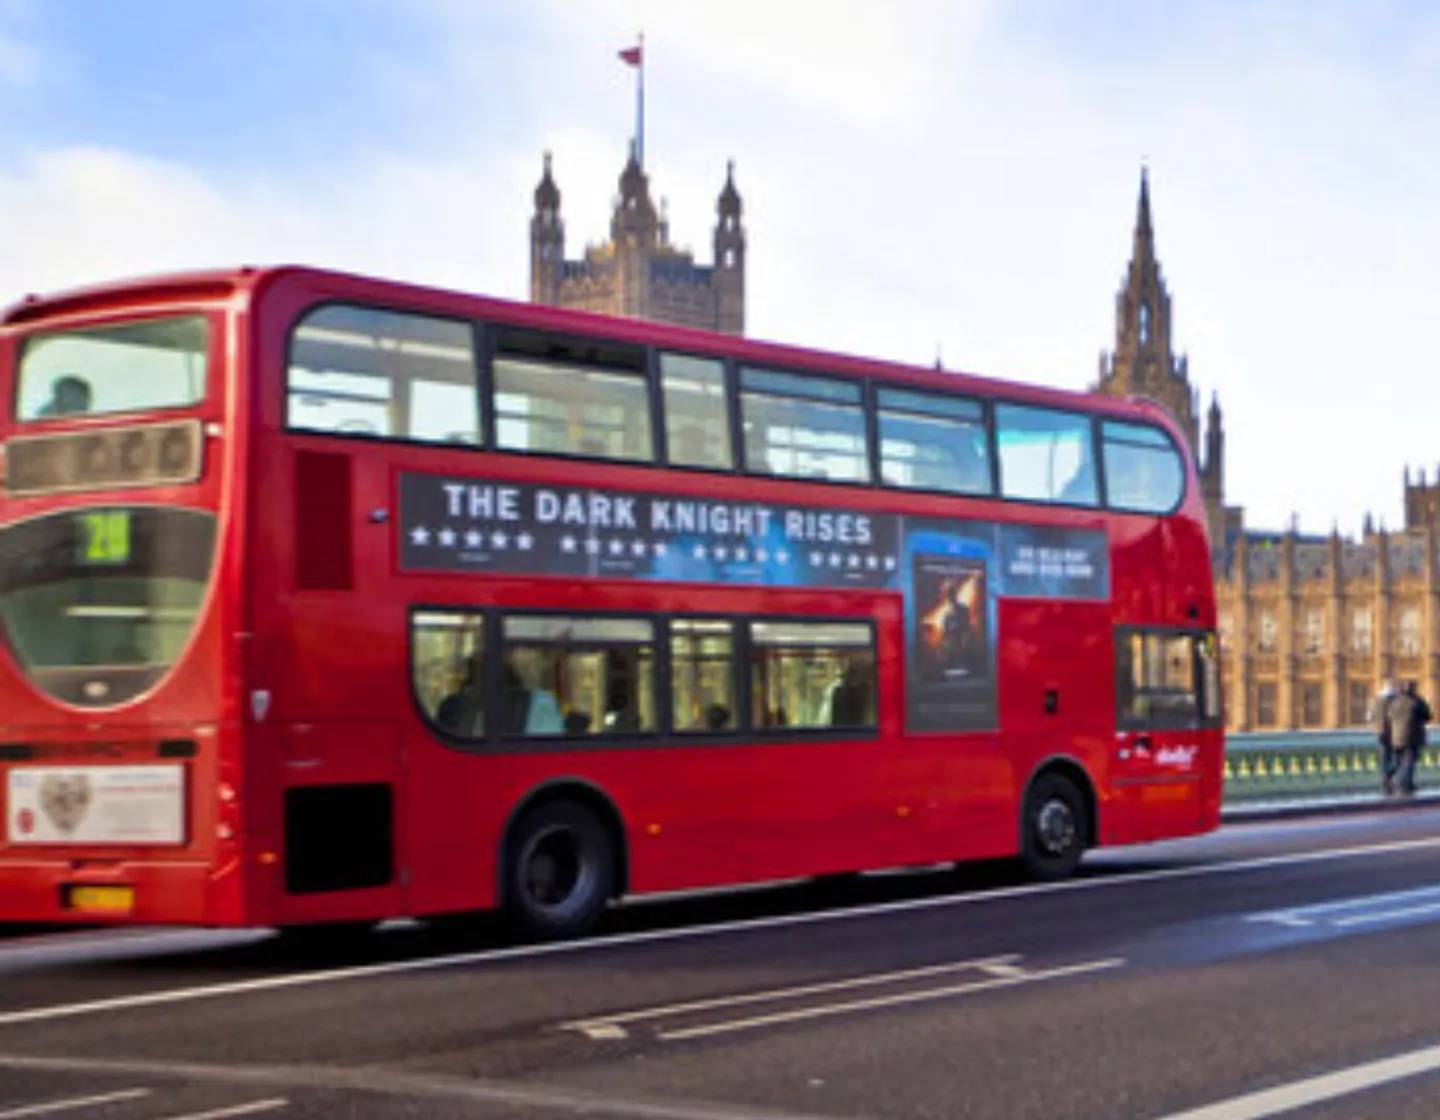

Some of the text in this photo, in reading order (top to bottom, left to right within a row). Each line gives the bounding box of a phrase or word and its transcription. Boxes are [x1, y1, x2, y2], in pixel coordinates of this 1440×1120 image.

[442, 483, 872, 545] THE DARK KNIGHT RISES
